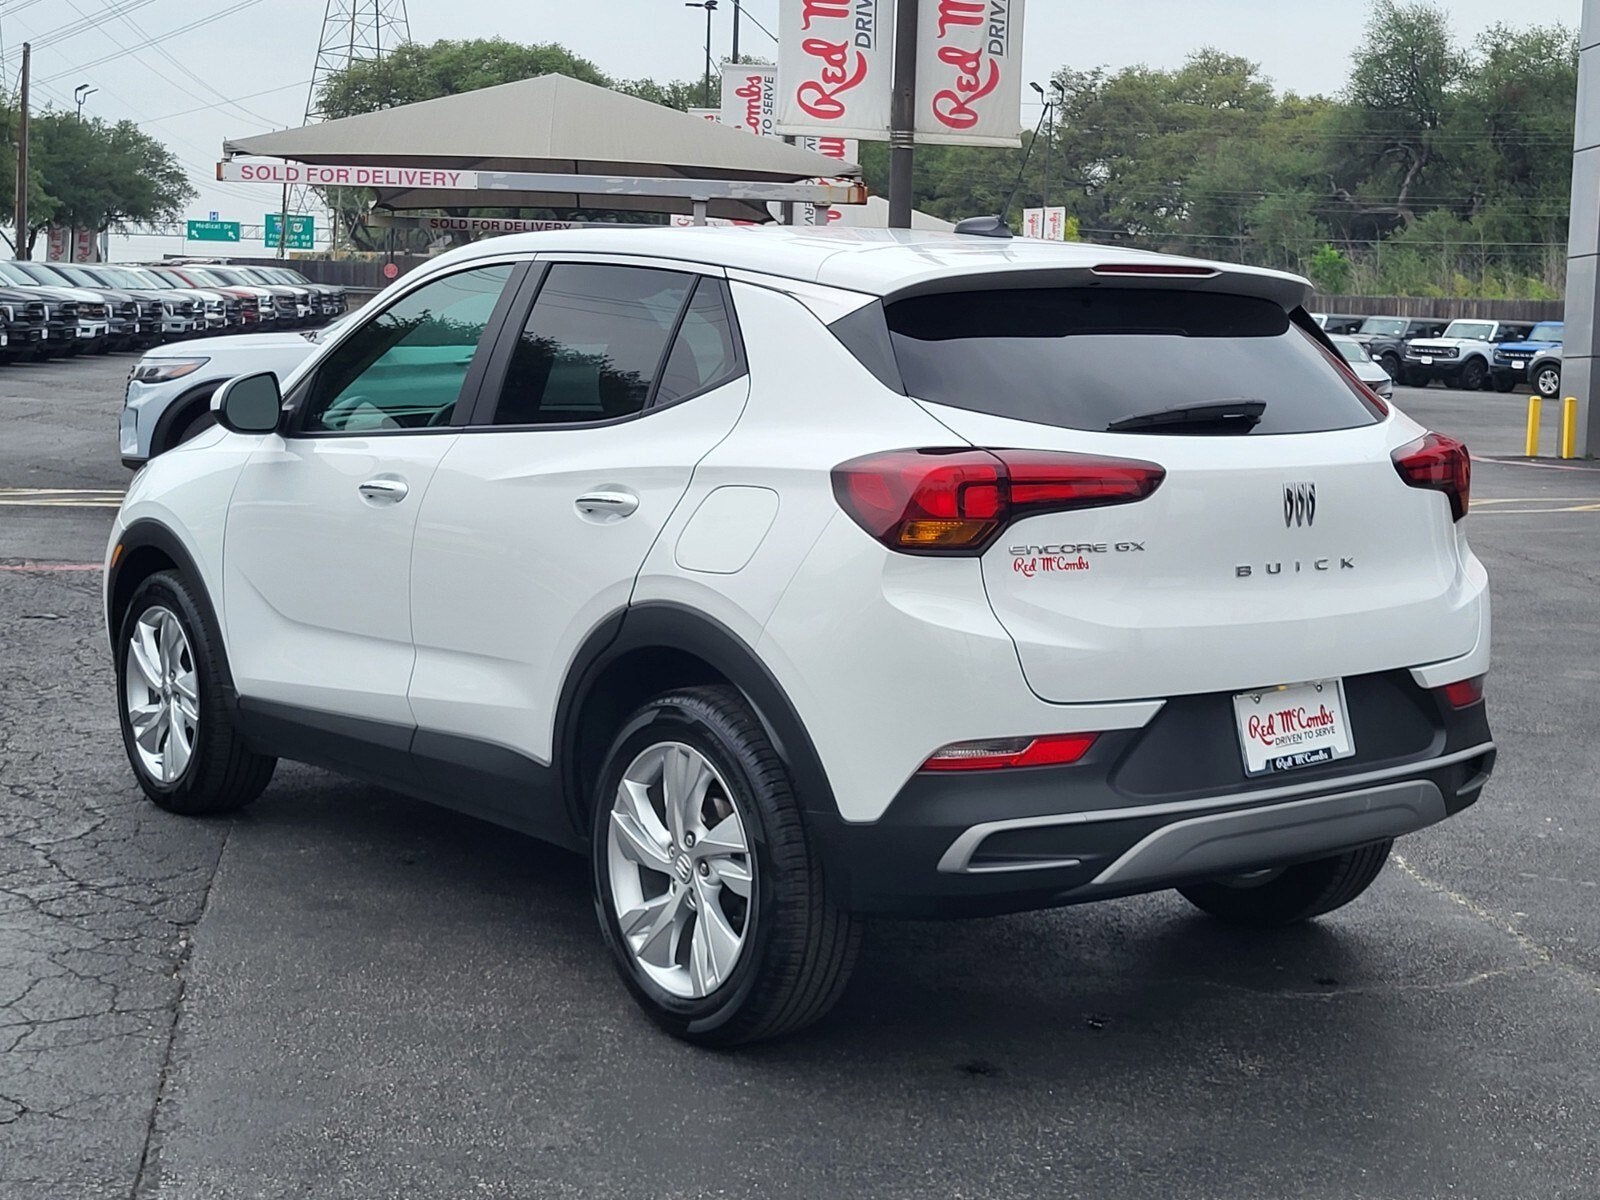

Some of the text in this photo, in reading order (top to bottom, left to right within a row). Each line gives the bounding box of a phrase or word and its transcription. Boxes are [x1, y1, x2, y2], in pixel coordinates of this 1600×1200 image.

[855, 0, 872, 49] DRIV
[988, 0, 1006, 56] DRIV
[797, 38, 867, 119] Red
[932, 46, 1000, 129] Red
[735, 75, 762, 135] ombs
[762, 76, 775, 136] TO SERVE
[241, 165, 461, 186] SOLD FOR DELIVERY
[430, 218, 572, 232] SOLD FOR DELIVERY
[1008, 541, 1146, 555] ENCORE GX
[1013, 558, 1037, 577] Red
[1235, 558, 1355, 578] BUICK
[1248, 714, 1276, 746] Red
[1275, 725, 1336, 746] DRIVEN TO SERVE
[1275, 757, 1293, 770] Red
